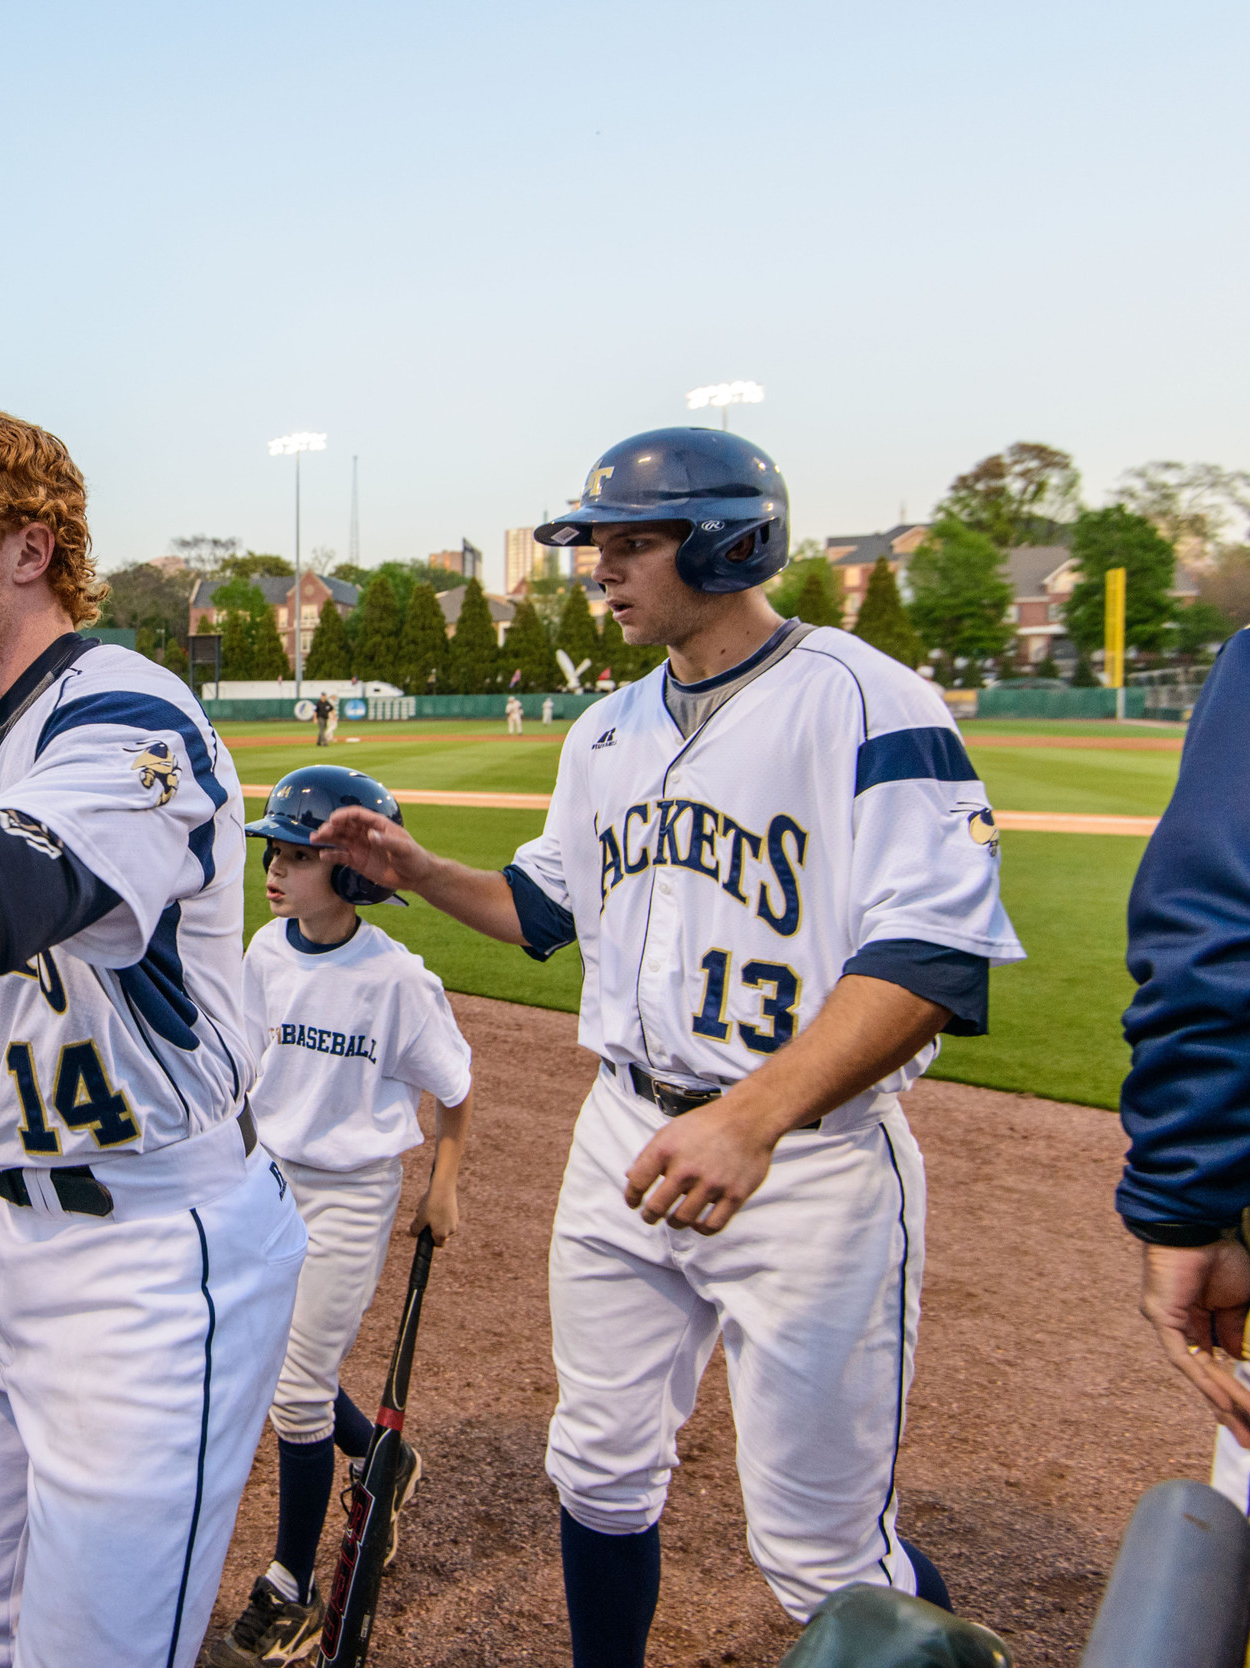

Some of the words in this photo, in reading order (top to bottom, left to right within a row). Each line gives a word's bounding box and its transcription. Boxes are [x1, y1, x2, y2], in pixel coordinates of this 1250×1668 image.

[594, 797, 810, 939] ACKETS
[281, 1023, 377, 1065] BASEBALL
[691, 946, 804, 1058] 13
[5, 1037, 143, 1157] 14
